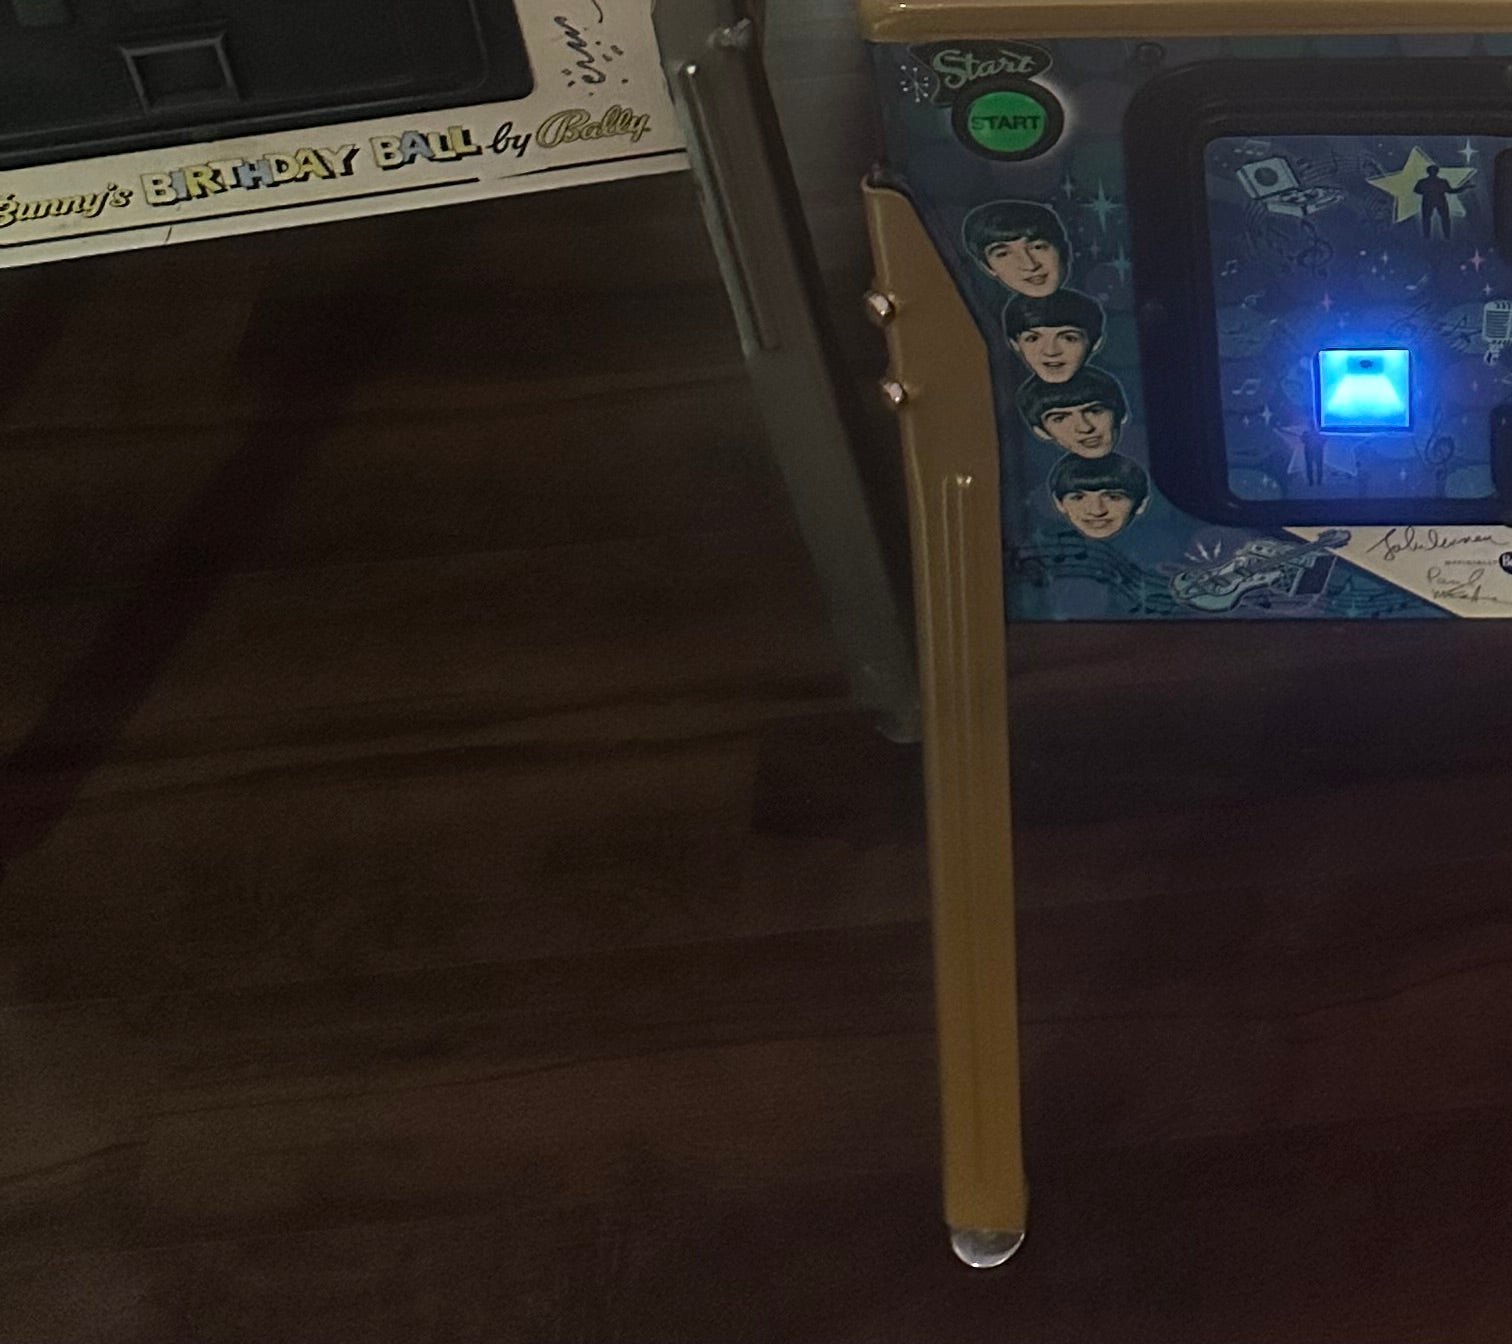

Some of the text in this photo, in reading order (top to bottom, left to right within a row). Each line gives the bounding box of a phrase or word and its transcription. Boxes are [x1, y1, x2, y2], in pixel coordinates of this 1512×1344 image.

[932, 49, 1037, 90] Start
[970, 114, 1042, 132] START
[140, 141, 360, 207] BIRTHDAY
[370, 126, 482, 169] BALL
[487, 122, 532, 160] by
[536, 107, 651, 148] Bally
